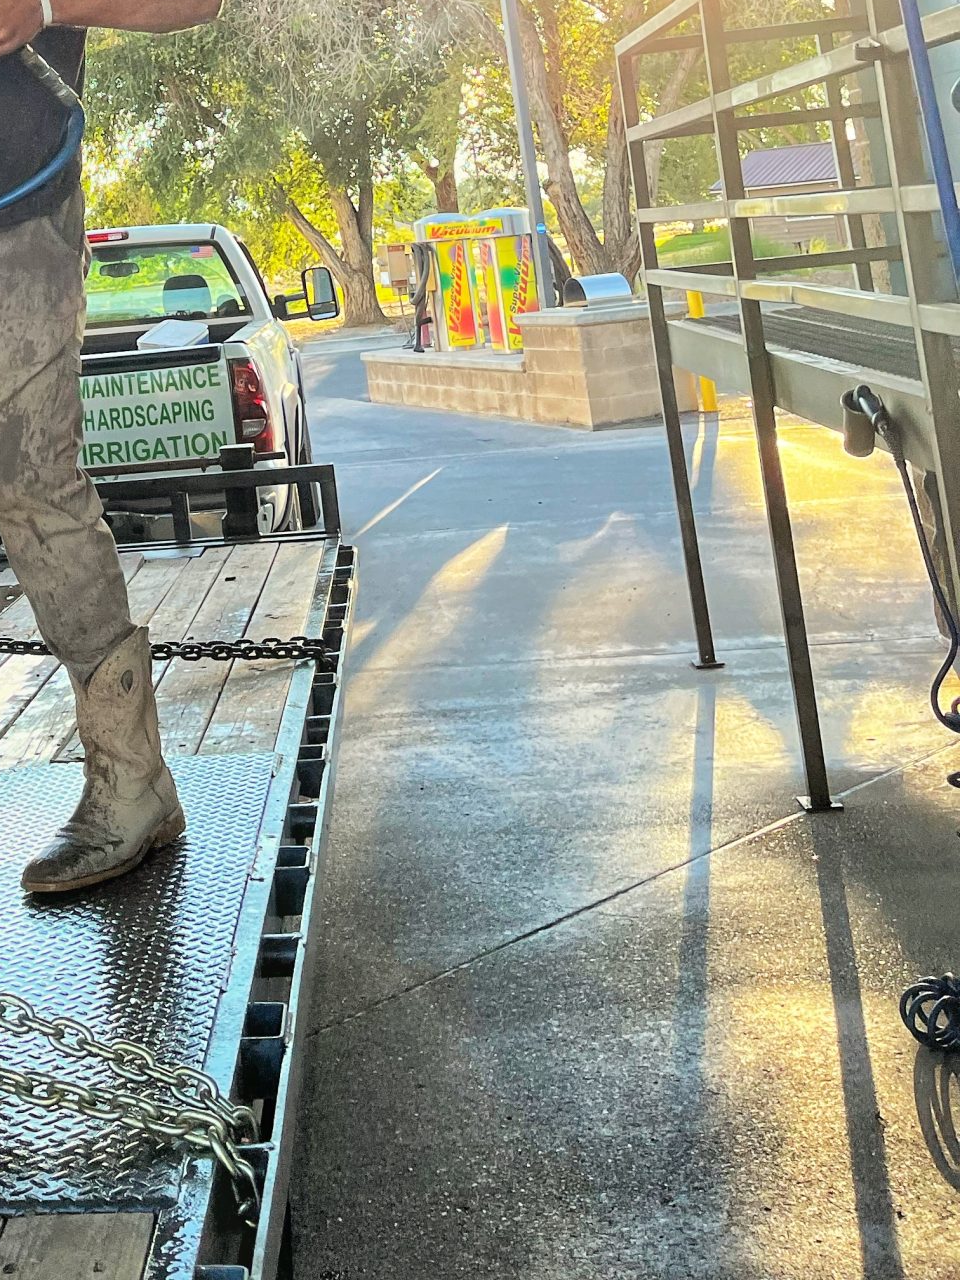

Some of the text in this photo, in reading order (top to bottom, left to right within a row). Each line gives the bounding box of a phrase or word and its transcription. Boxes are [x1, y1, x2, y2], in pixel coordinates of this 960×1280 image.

[448, 243, 464, 333] Vacuum
[510, 259, 522, 314] Super Vac
[80, 364, 221, 400] MAINTENANCE
[84, 399, 215, 432] HARDSCAPING
[82, 430, 228, 466] IRRIGATION
